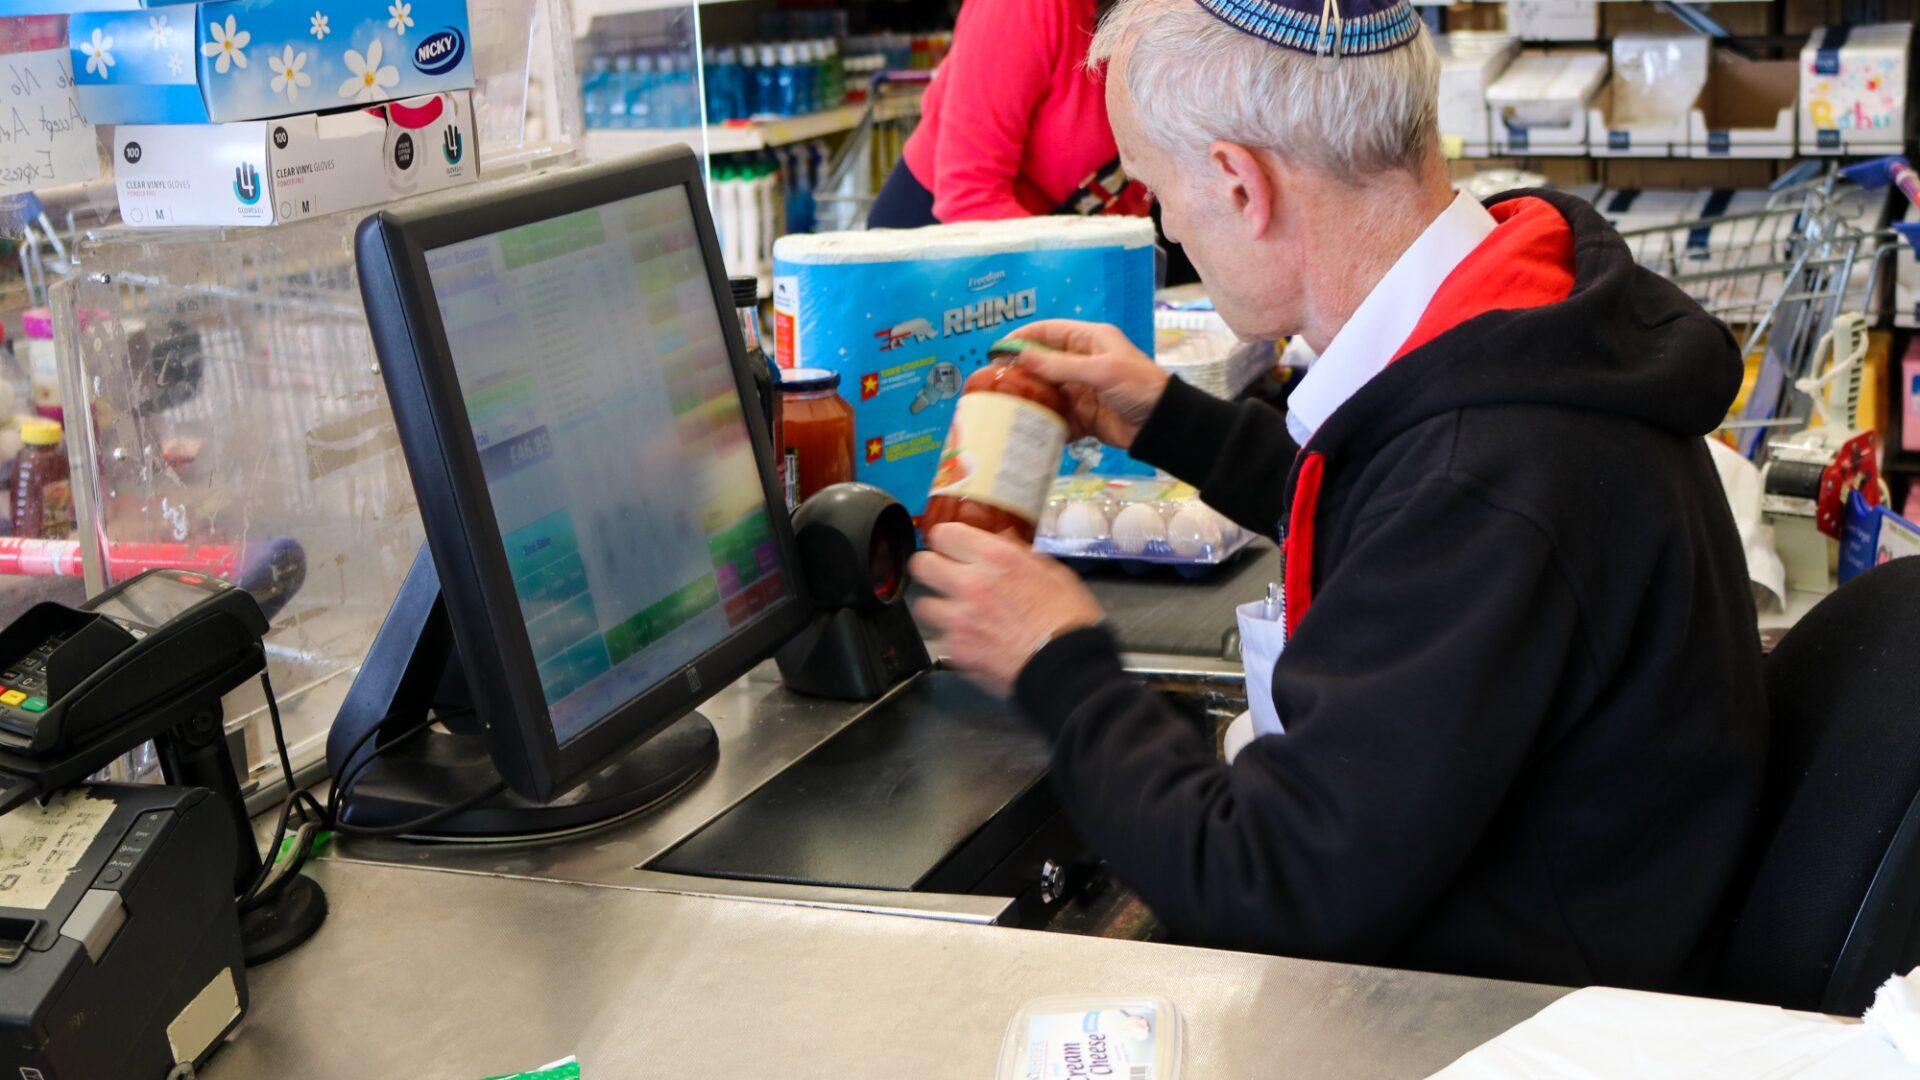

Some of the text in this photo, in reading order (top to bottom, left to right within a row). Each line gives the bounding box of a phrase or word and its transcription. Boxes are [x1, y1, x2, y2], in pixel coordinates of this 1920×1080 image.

[418, 35, 453, 62] NICKY
[275, 132, 287, 144] 100
[126, 148, 139, 158] 100
[276, 159, 335, 179] CLEAR VINYL GLOVES
[126, 180, 191, 190] CLEAR VINYL GLOVES
[155, 209, 165, 220] M
[302, 200, 310, 213] M
[968, 270, 1006, 287] Freedom
[943, 287, 1038, 338] RHINO
[1063, 1042, 1092, 1080] ream
[1088, 1033, 1113, 1076] Cheese
